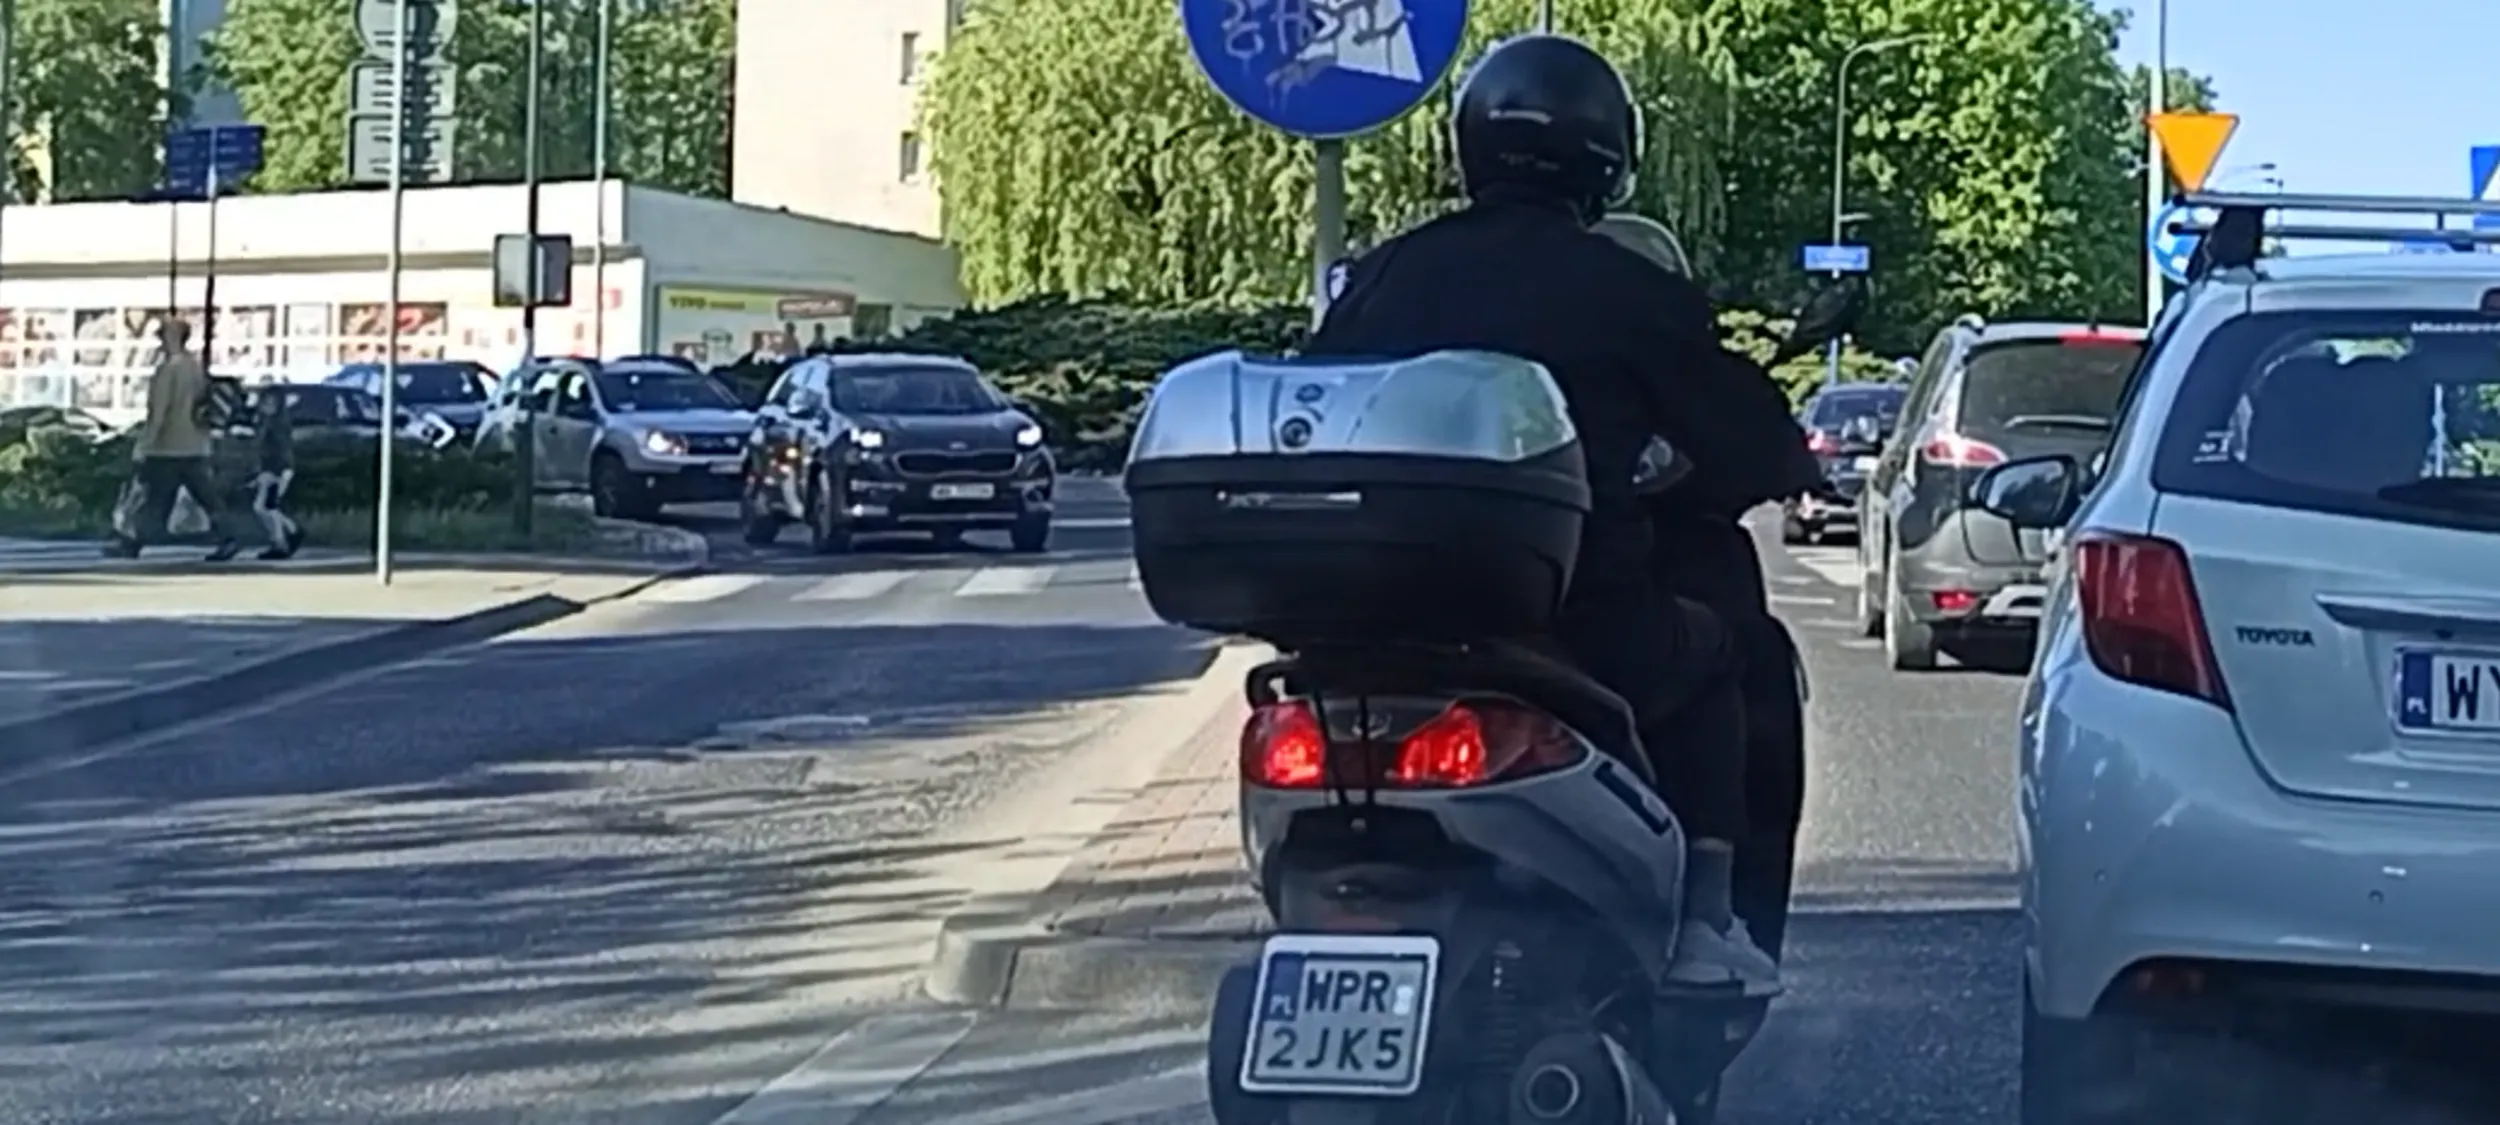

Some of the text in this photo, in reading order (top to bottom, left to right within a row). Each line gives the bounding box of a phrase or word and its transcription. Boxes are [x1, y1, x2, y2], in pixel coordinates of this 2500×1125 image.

[2235, 626, 2315, 646] TOYOTA
[1305, 969, 1391, 1014] WPR
[1266, 1026, 1404, 1071] 2JK5
